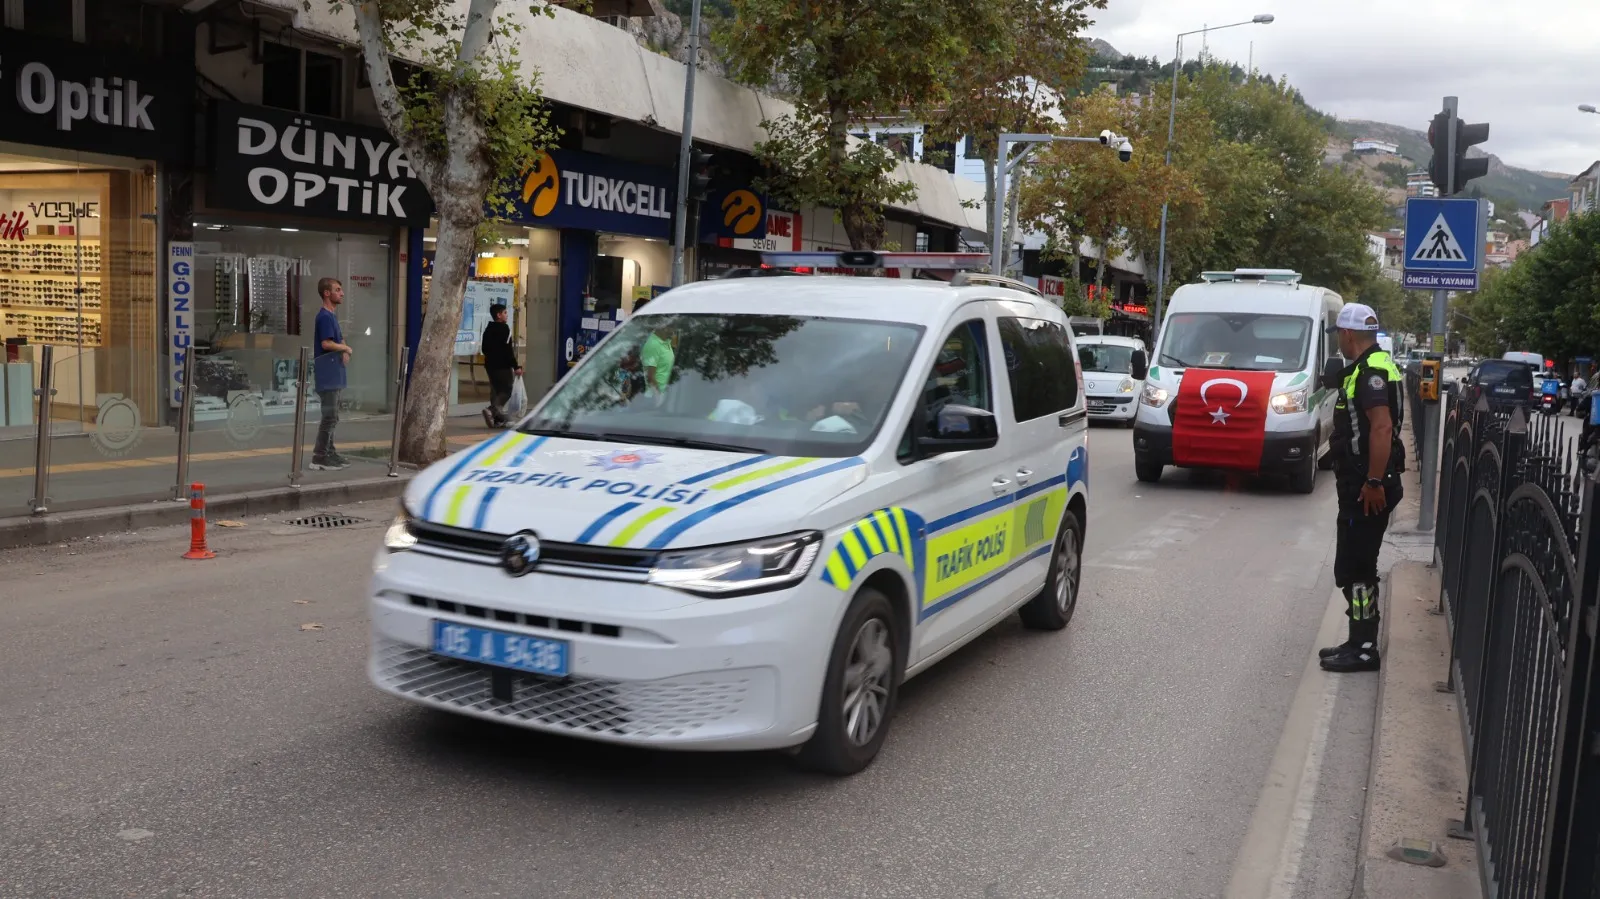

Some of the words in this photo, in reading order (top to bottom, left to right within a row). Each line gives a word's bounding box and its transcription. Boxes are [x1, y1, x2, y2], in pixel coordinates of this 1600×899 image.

[18, 61, 155, 131] Optik
[238, 117, 417, 180] DÜNYA
[248, 166, 407, 218] OPTİK
[562, 170, 671, 219] TURKCELL
[172, 244, 192, 257] FENNİ
[752, 239, 777, 251] SEVEN
[1406, 275, 1439, 285] ÖNCELİK
[1440, 277, 1474, 286] YAYANIN
[462, 470, 581, 489] TRAFİK
[581, 479, 708, 504] POLİSİ
[936, 538, 974, 583] TRAFİK
[976, 521, 1006, 565] POLİSİ
